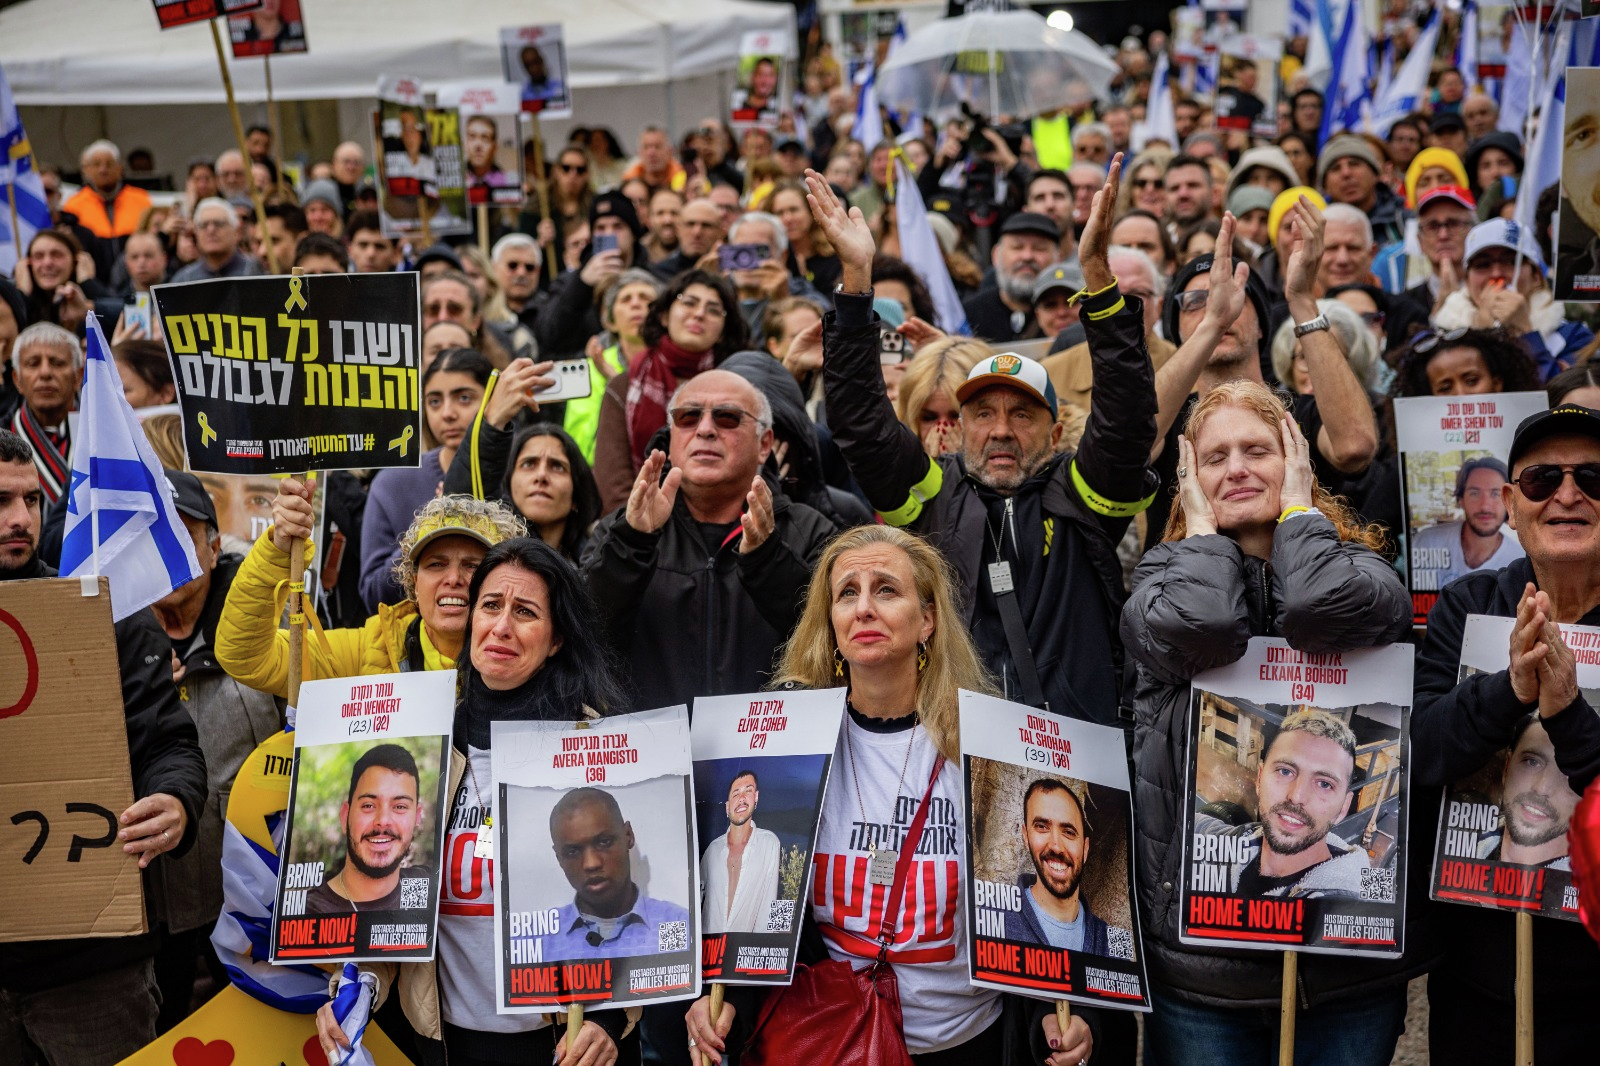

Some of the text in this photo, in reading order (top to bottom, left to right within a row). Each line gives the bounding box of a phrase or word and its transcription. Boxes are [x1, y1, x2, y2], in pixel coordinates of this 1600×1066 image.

[165, 313, 414, 367] ושבו כל הבנים
[178, 350, 418, 411] והבנות לגבולם
[1446, 402, 1496, 416] עומר שם טוב
[1441, 416, 1503, 430] OMER SHEM TOV
[1412, 547, 1451, 569] BRING
[1412, 569, 1438, 590] HIM
[1570, 631, 1600, 648] לקנה
[1260, 665, 1348, 685] ELKANA BOHBOT
[351, 682, 394, 701] עומר ונקרט
[1292, 683, 1315, 702] (34)
[342, 698, 401, 718] OMER WENKERT
[748, 700, 784, 718] אליה כהן
[348, 719, 372, 736] (23)
[738, 717, 787, 733] ELIYA COHEN
[1027, 714, 1060, 735] טל שהם
[562, 734, 628, 752] אברה מנגיסטו
[749, 733, 766, 749] (27)
[1019, 728, 1072, 755] TAL SHOHAM
[264, 754, 292, 776] חרון
[552, 749, 638, 768] AVERA MANGISTO
[1025, 747, 1051, 766] (39)
[586, 767, 606, 783] (36)
[1448, 801, 1499, 832] BRING
[1192, 833, 1251, 864] BRING
[1444, 830, 1477, 859] HIM
[285, 861, 324, 889] BRING
[1191, 862, 1227, 892] HIM
[1440, 860, 1544, 899] HOME NOW!
[282, 889, 308, 916] HIM
[813, 853, 959, 944] עכשי
[974, 880, 1022, 912] BRING
[510, 909, 560, 937] BRING
[975, 909, 1006, 939] HIM
[1189, 896, 1303, 931] HOME NOW!
[1324, 914, 1394, 928] HOSTAGES AND MISSING
[280, 914, 357, 946] HOME NOW!
[369, 932, 427, 946] FAMILIES FORUM
[1323, 923, 1394, 942] FAMILIES FORUM
[510, 938, 543, 964] HIM
[702, 934, 727, 965] OW!
[976, 939, 1071, 980] HOME NOW!
[630, 964, 689, 976] HOSTAGES AND MISSING
[736, 956, 787, 970] FAMILIES FORUM
[511, 960, 612, 994] HOME NOW!
[630, 973, 690, 990] FAMILIES FORUM
[1086, 975, 1141, 996] FAMILIES FORUM
